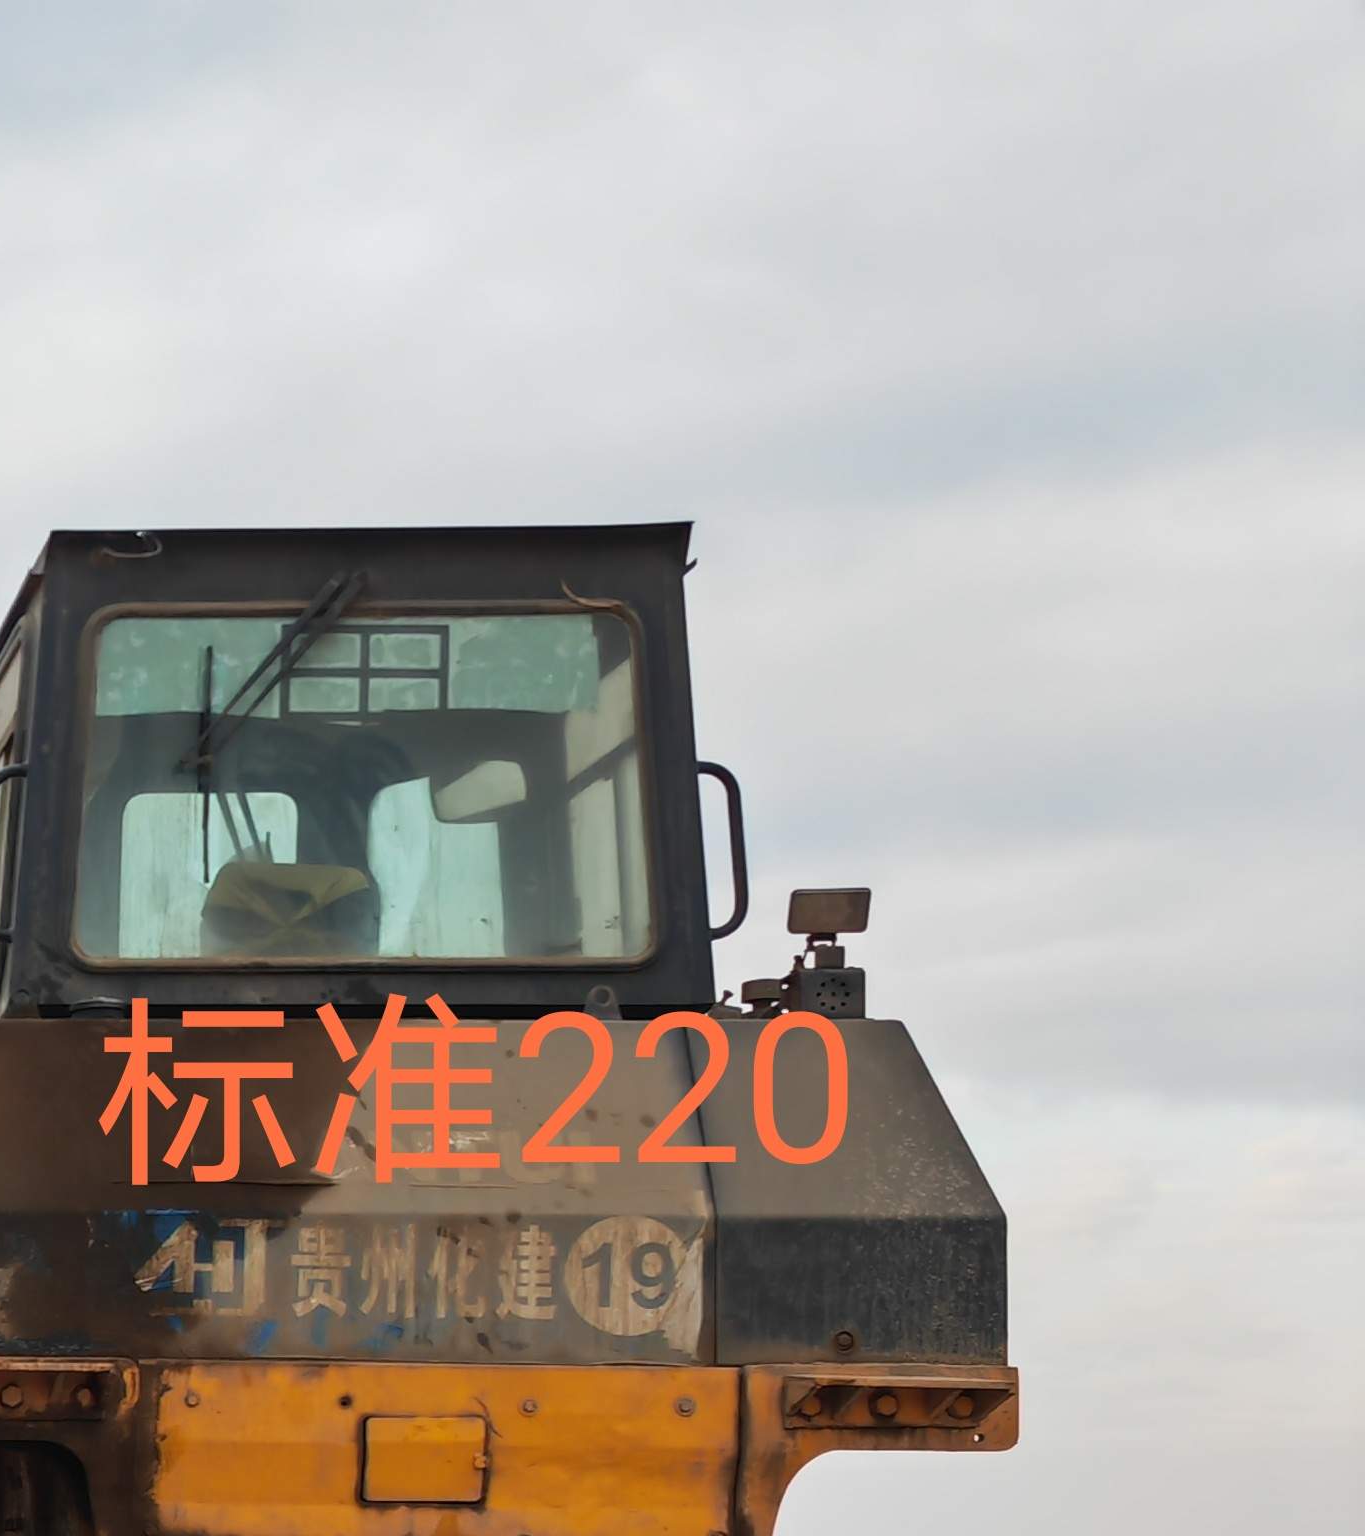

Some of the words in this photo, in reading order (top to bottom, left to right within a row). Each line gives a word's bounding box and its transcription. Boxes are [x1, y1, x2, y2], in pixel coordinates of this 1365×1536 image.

[290, 1220, 557, 1320] 贵州化建
[581, 1241, 676, 1310] 19
